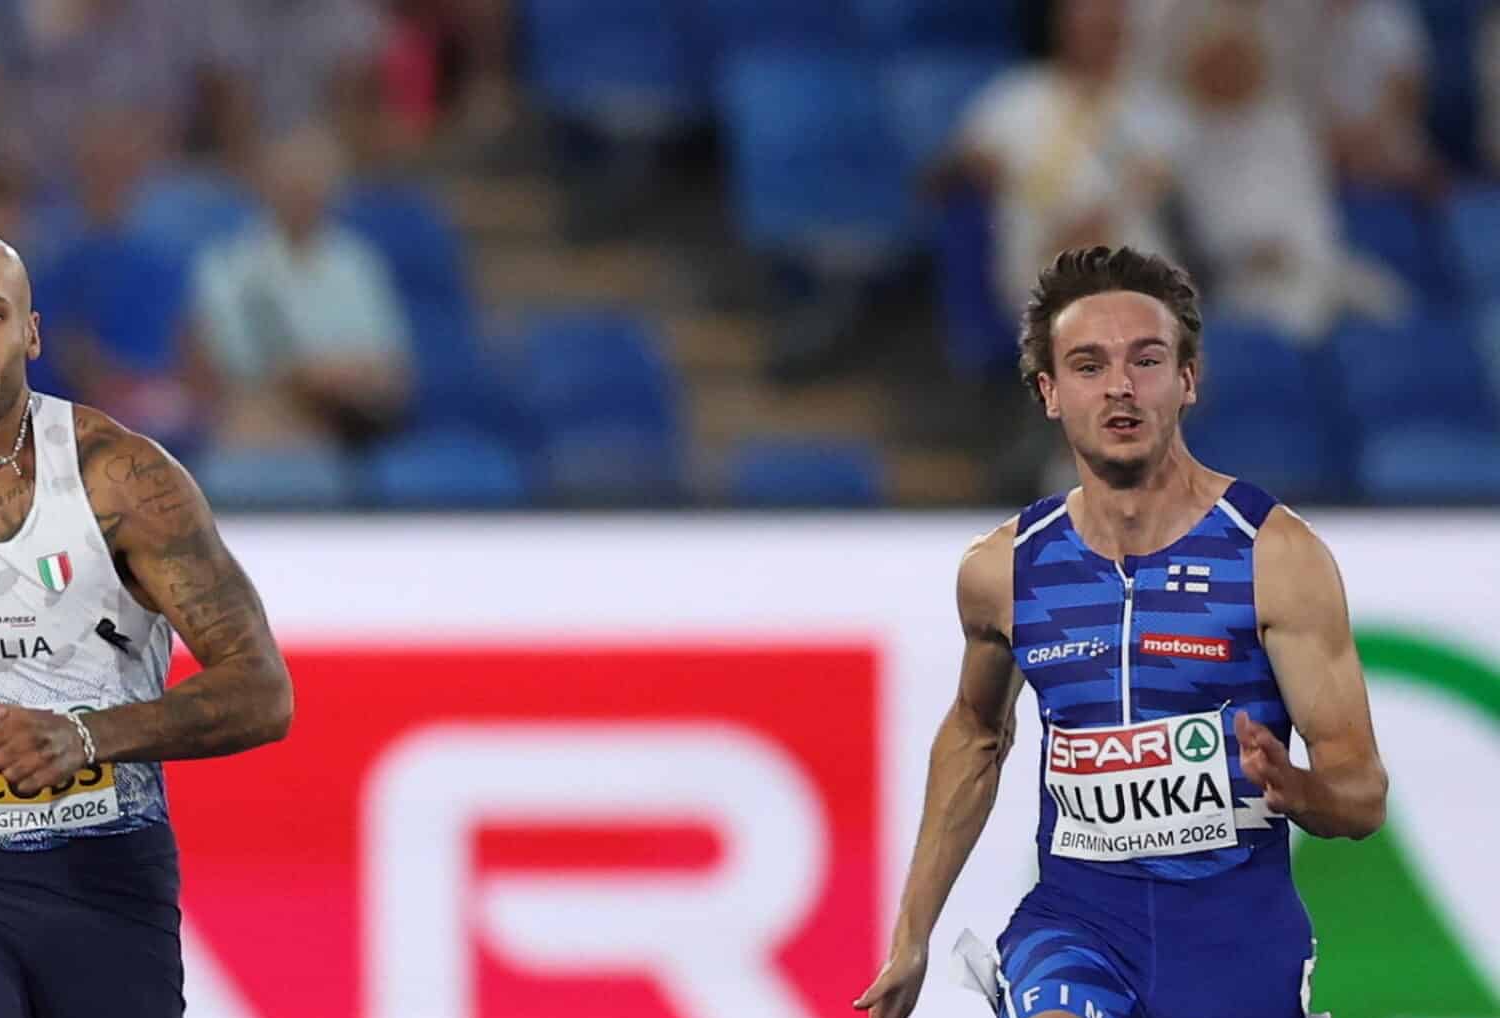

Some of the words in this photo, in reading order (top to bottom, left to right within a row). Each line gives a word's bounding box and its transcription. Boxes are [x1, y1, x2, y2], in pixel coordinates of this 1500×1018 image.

[1027, 641, 1089, 664] CRAFT
[1143, 639, 1226, 657] motonet
[1052, 728, 1168, 769] SPAR
[61, 799, 108, 822] 2026
[1050, 772, 1225, 824] ILLUKKA
[1061, 831, 1174, 852] BIRMINGHAM
[1180, 823, 1227, 844] 2026
